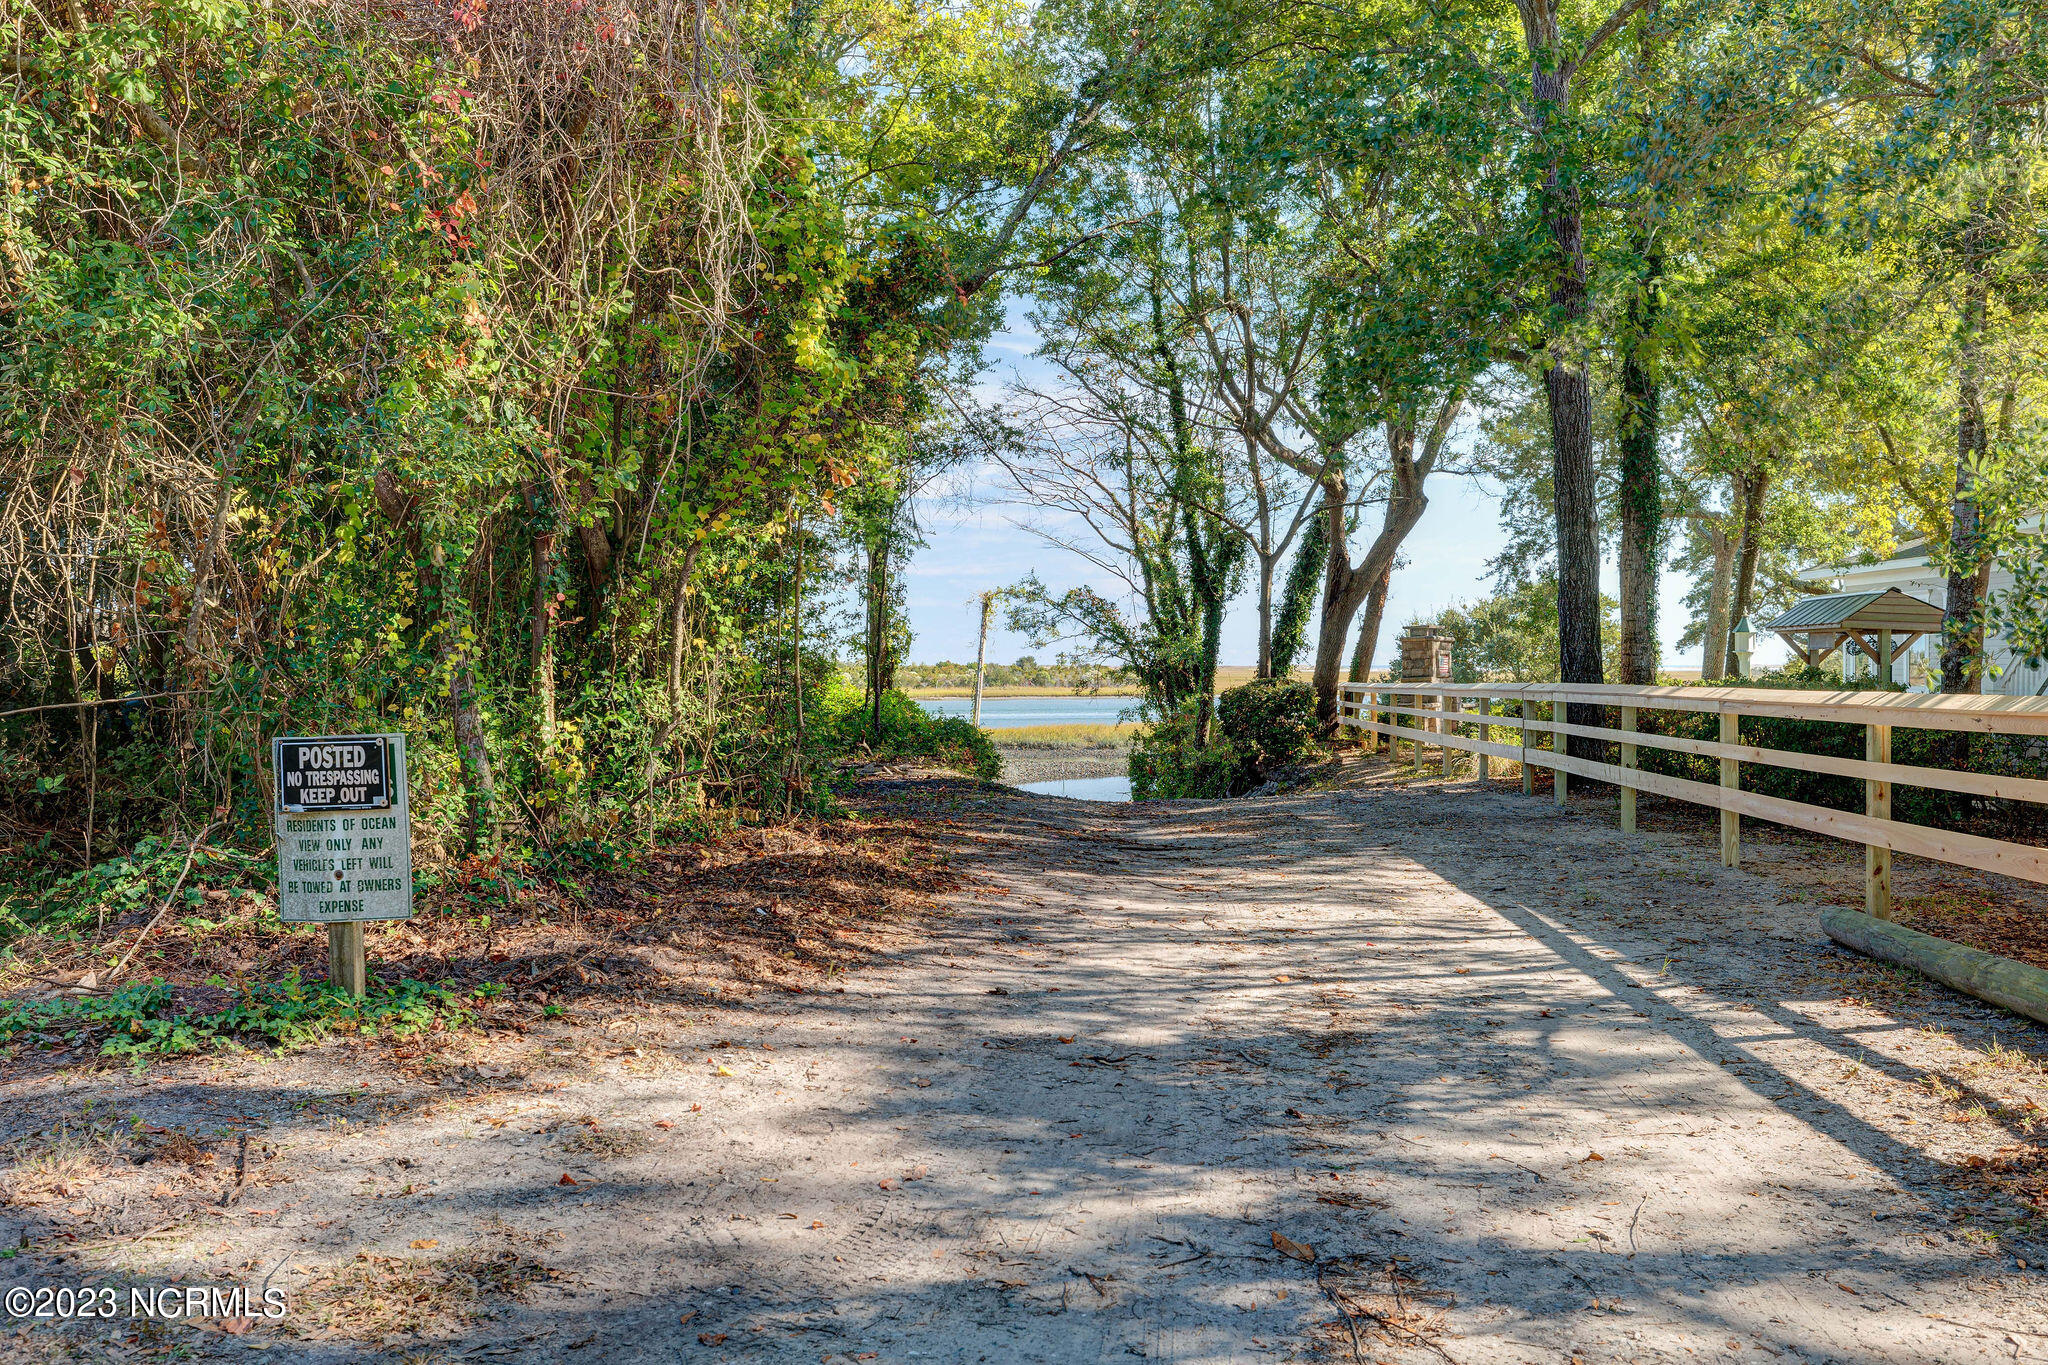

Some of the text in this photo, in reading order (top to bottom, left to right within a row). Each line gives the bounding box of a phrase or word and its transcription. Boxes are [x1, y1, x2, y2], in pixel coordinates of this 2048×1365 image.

[298, 745, 366, 769] POSTED
[286, 769, 380, 787] NO TRESPASSING
[300, 786, 368, 804] KEEP OUT
[286, 816, 396, 832] RESIDENTS OF OCEAN
[298, 837, 384, 852] VIEW ONLY ANY
[293, 856, 394, 872] VEHICLES LEFT WILL
[288, 878, 402, 894] BE TOWED AT OWNERS
[319, 899, 364, 914] EXPENSE
